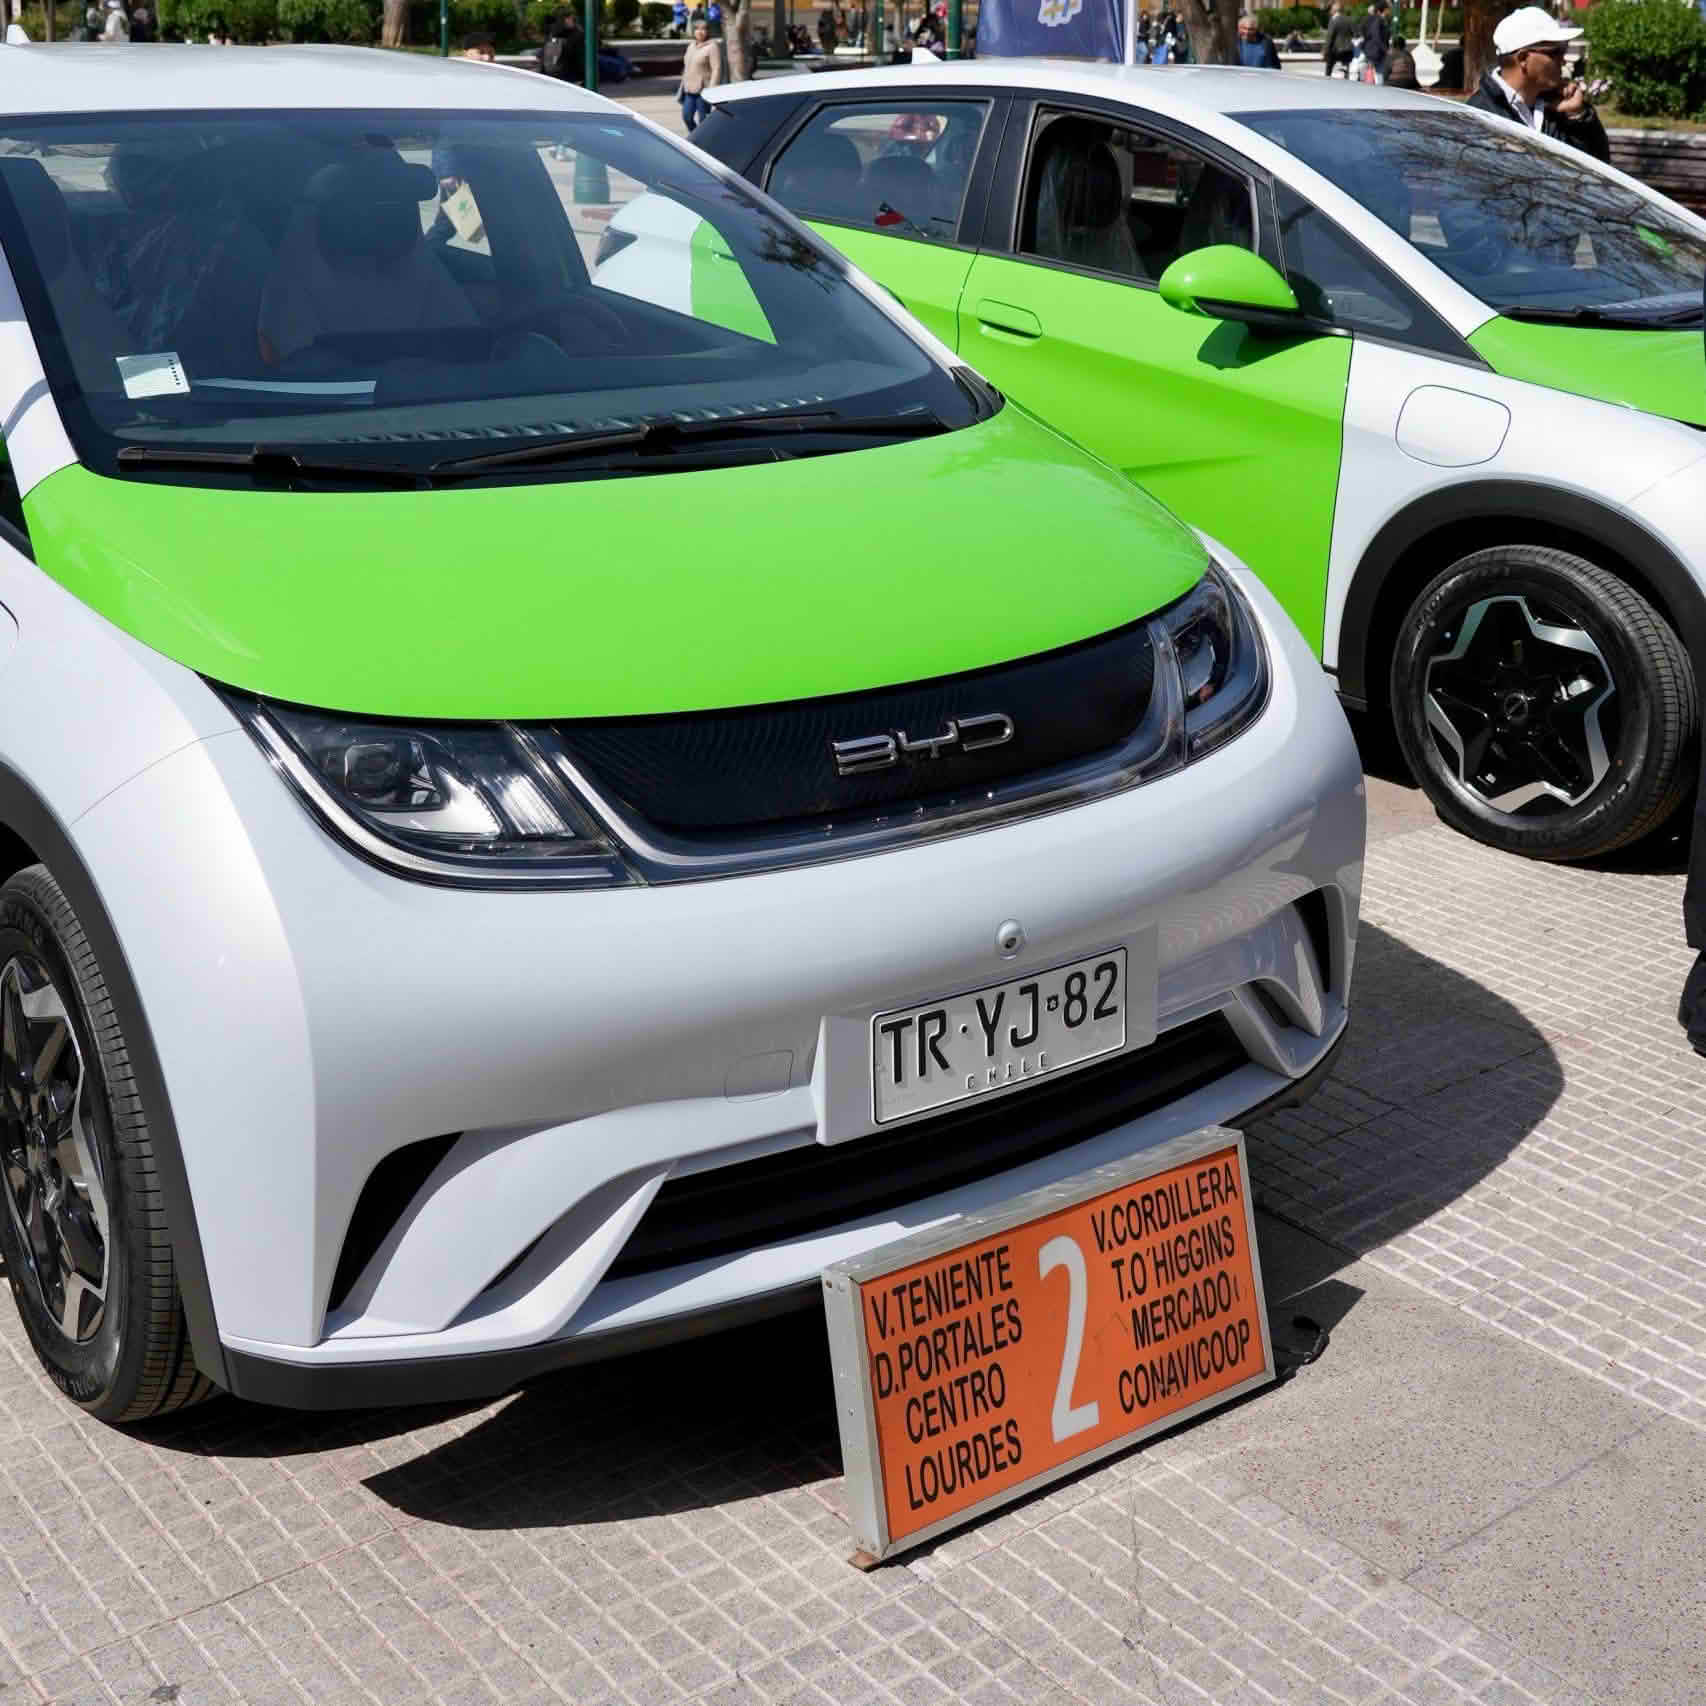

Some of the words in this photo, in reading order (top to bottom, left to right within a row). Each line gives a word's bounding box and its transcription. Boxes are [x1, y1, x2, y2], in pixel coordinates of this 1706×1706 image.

[832, 713, 1015, 776] BYD
[965, 1051, 1050, 1091] CHILE
[1091, 1161, 1238, 1253] V.CORDILLERA
[871, 1245, 1013, 1340] V.TENIENTE
[874, 1298, 1022, 1399] D.PORTALES
[1038, 1235, 1100, 1444] 2
[1119, 1318, 1250, 1415] CONAVICOOP
[906, 1362, 1006, 1445] CENTRO
[905, 1418, 1023, 1511] LOURDES
